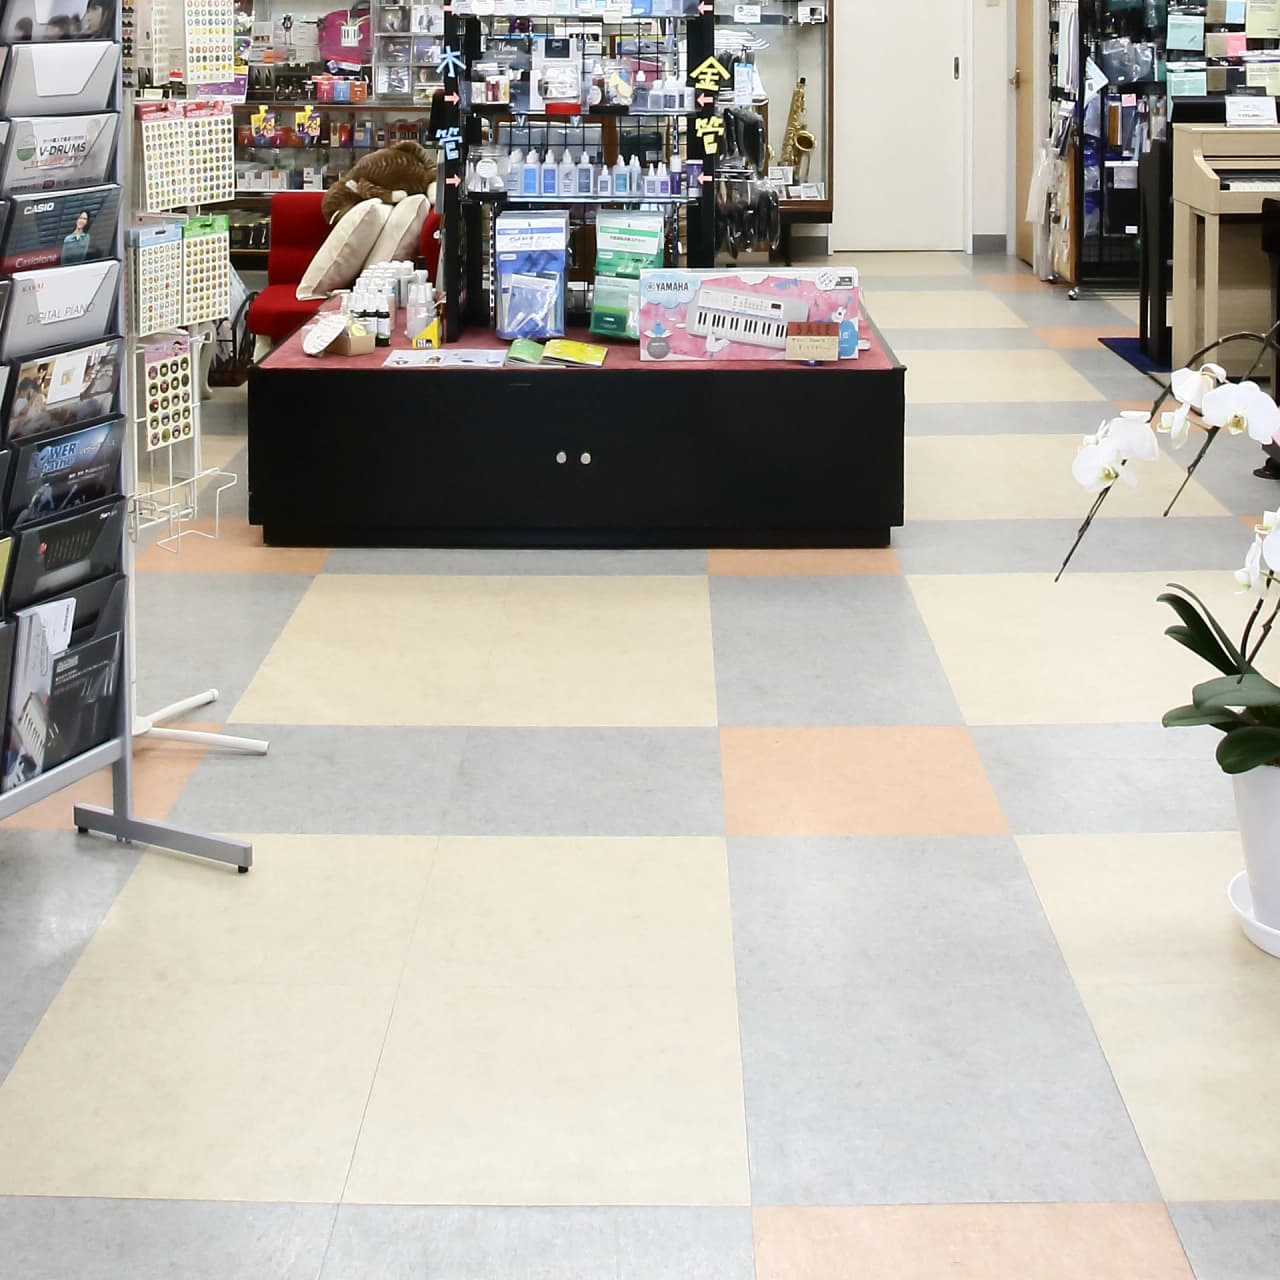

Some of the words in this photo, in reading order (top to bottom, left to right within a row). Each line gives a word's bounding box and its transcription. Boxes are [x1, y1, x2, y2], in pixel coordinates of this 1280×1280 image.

[40, 141, 87, 157] V-DRUMS
[24, 202, 55, 216] CASIO
[16, 254, 58, 268] Casiotone
[655, 282, 689, 294] YAMAHA
